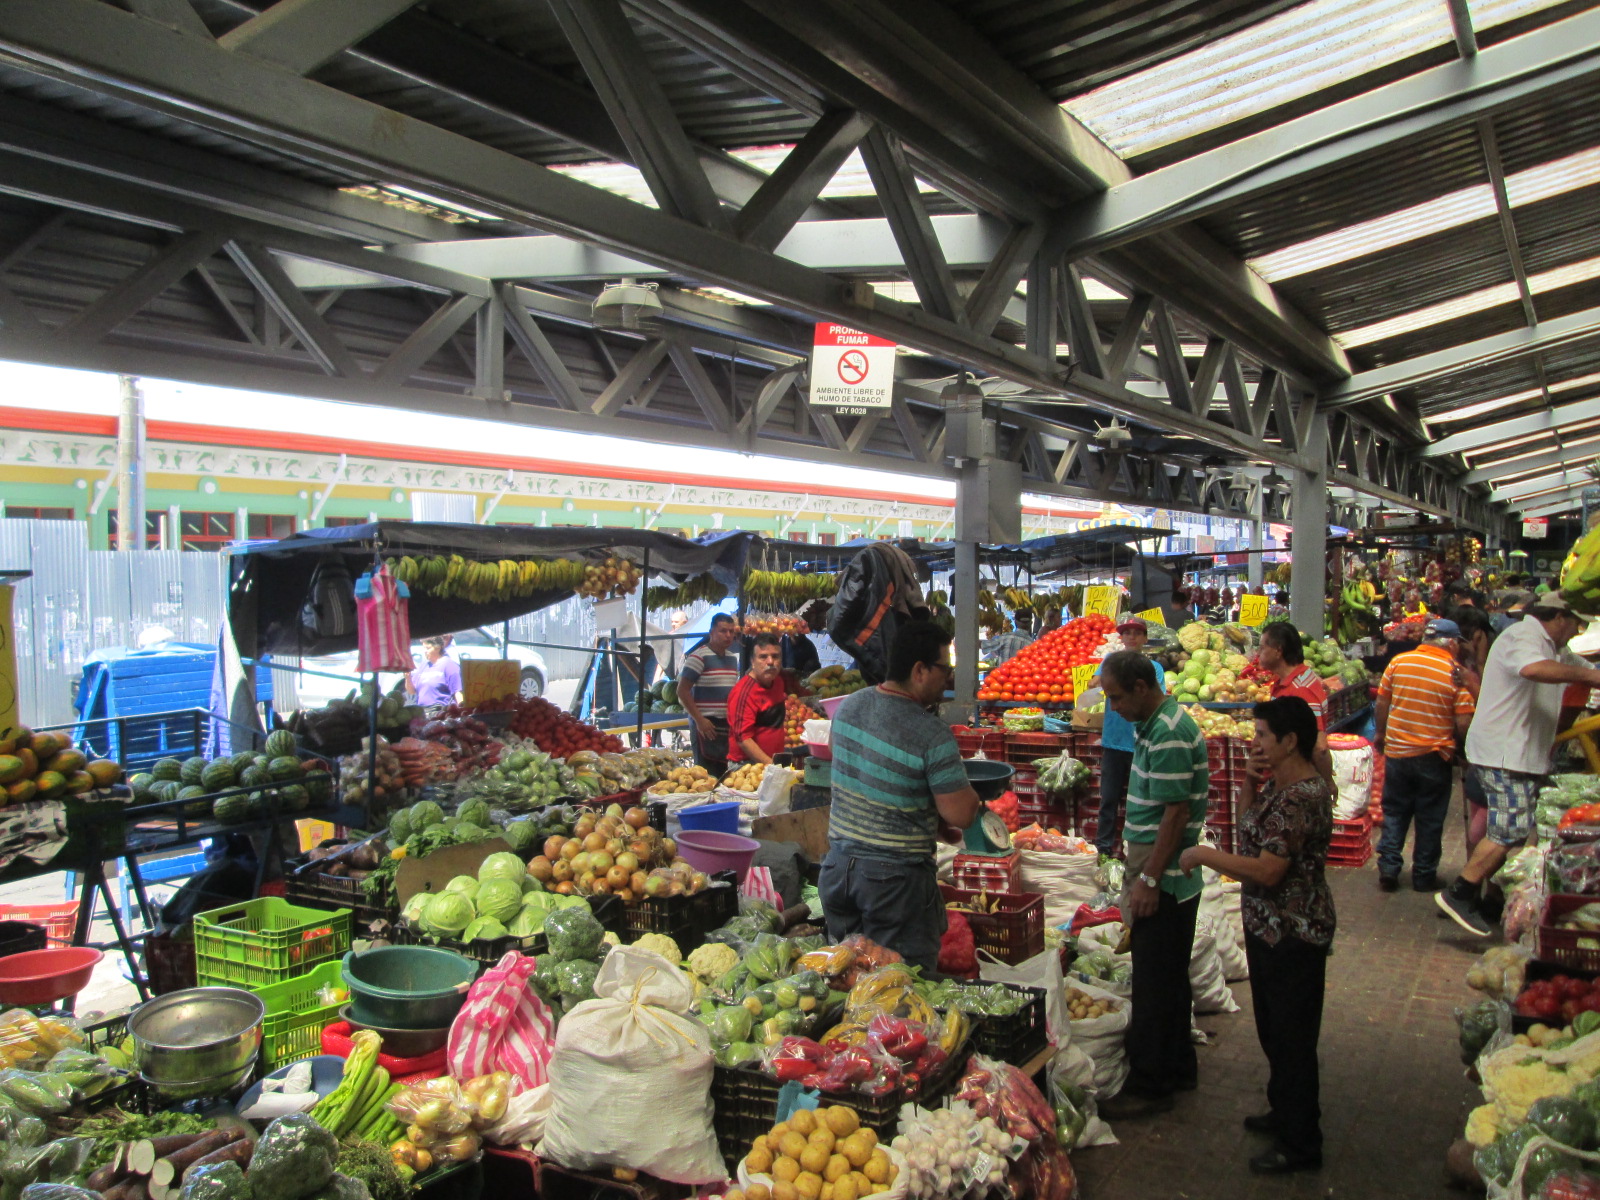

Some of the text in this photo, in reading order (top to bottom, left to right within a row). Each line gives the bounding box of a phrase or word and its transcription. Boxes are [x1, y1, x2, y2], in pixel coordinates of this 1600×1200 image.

[829, 325, 867, 334] PROH
[837, 335, 869, 344] FUMAR
[816, 387, 852, 395] AMBIENTE
[853, 396, 881, 404] TABACO
[850, 407, 867, 415] 9028
[1241, 602, 1267, 619] 500
